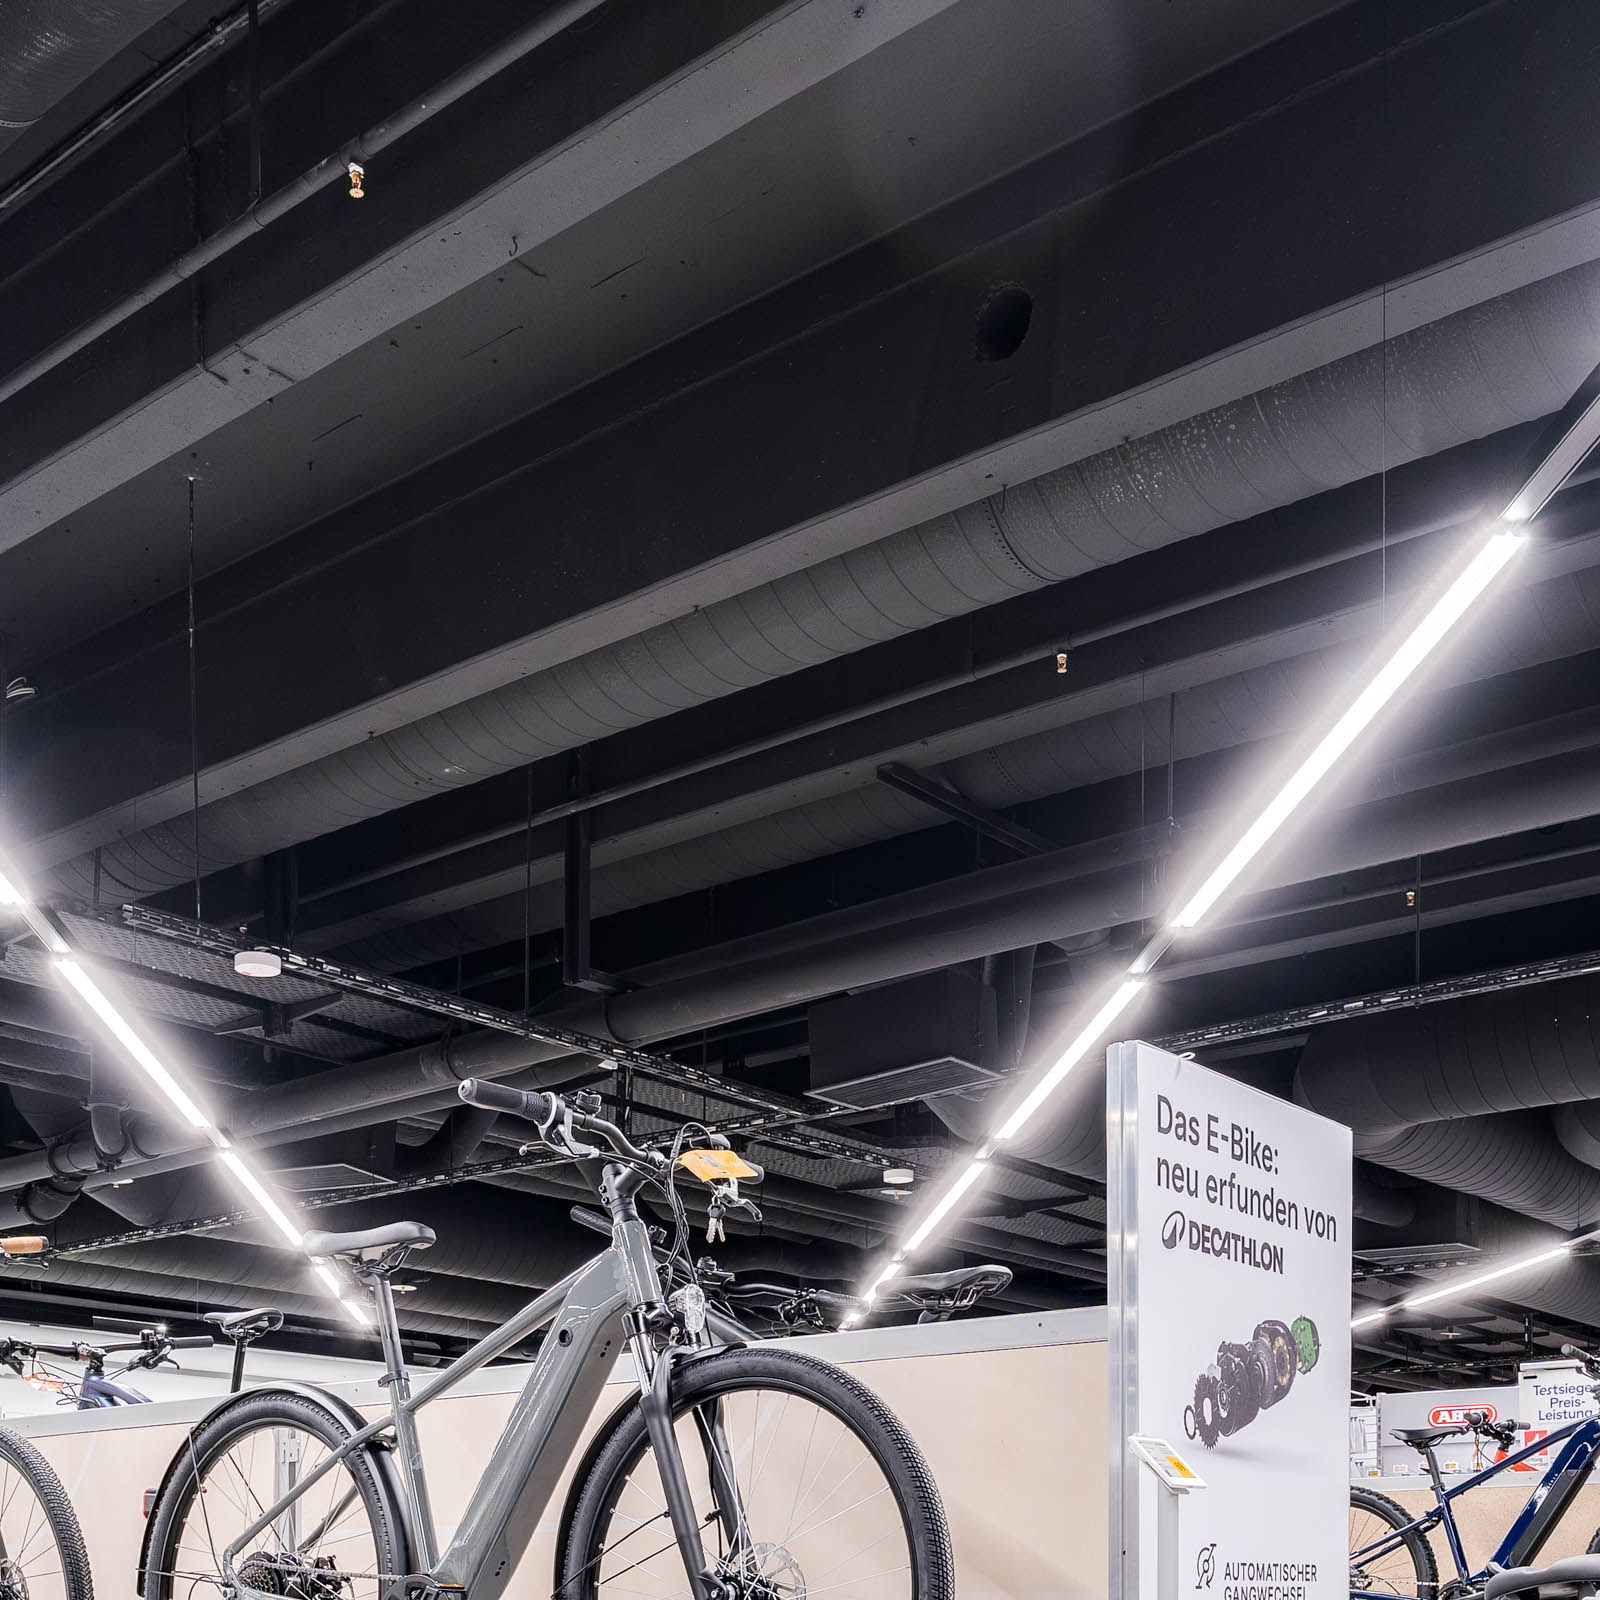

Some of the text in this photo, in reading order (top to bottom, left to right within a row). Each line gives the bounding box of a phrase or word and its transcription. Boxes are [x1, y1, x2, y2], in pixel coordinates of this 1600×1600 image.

[1157, 1094, 1278, 1175] Das E-Bike:
[1157, 1157, 1337, 1242] neu erfunden von
[1188, 1220, 1284, 1274] DECATHLON
[1533, 1383, 1593, 1396] Testsiege
[1550, 1397, 1585, 1409] Preis-
[1538, 1409, 1593, 1421] Leistung
[1223, 1562, 1318, 1582] AUTOMATISCHER
